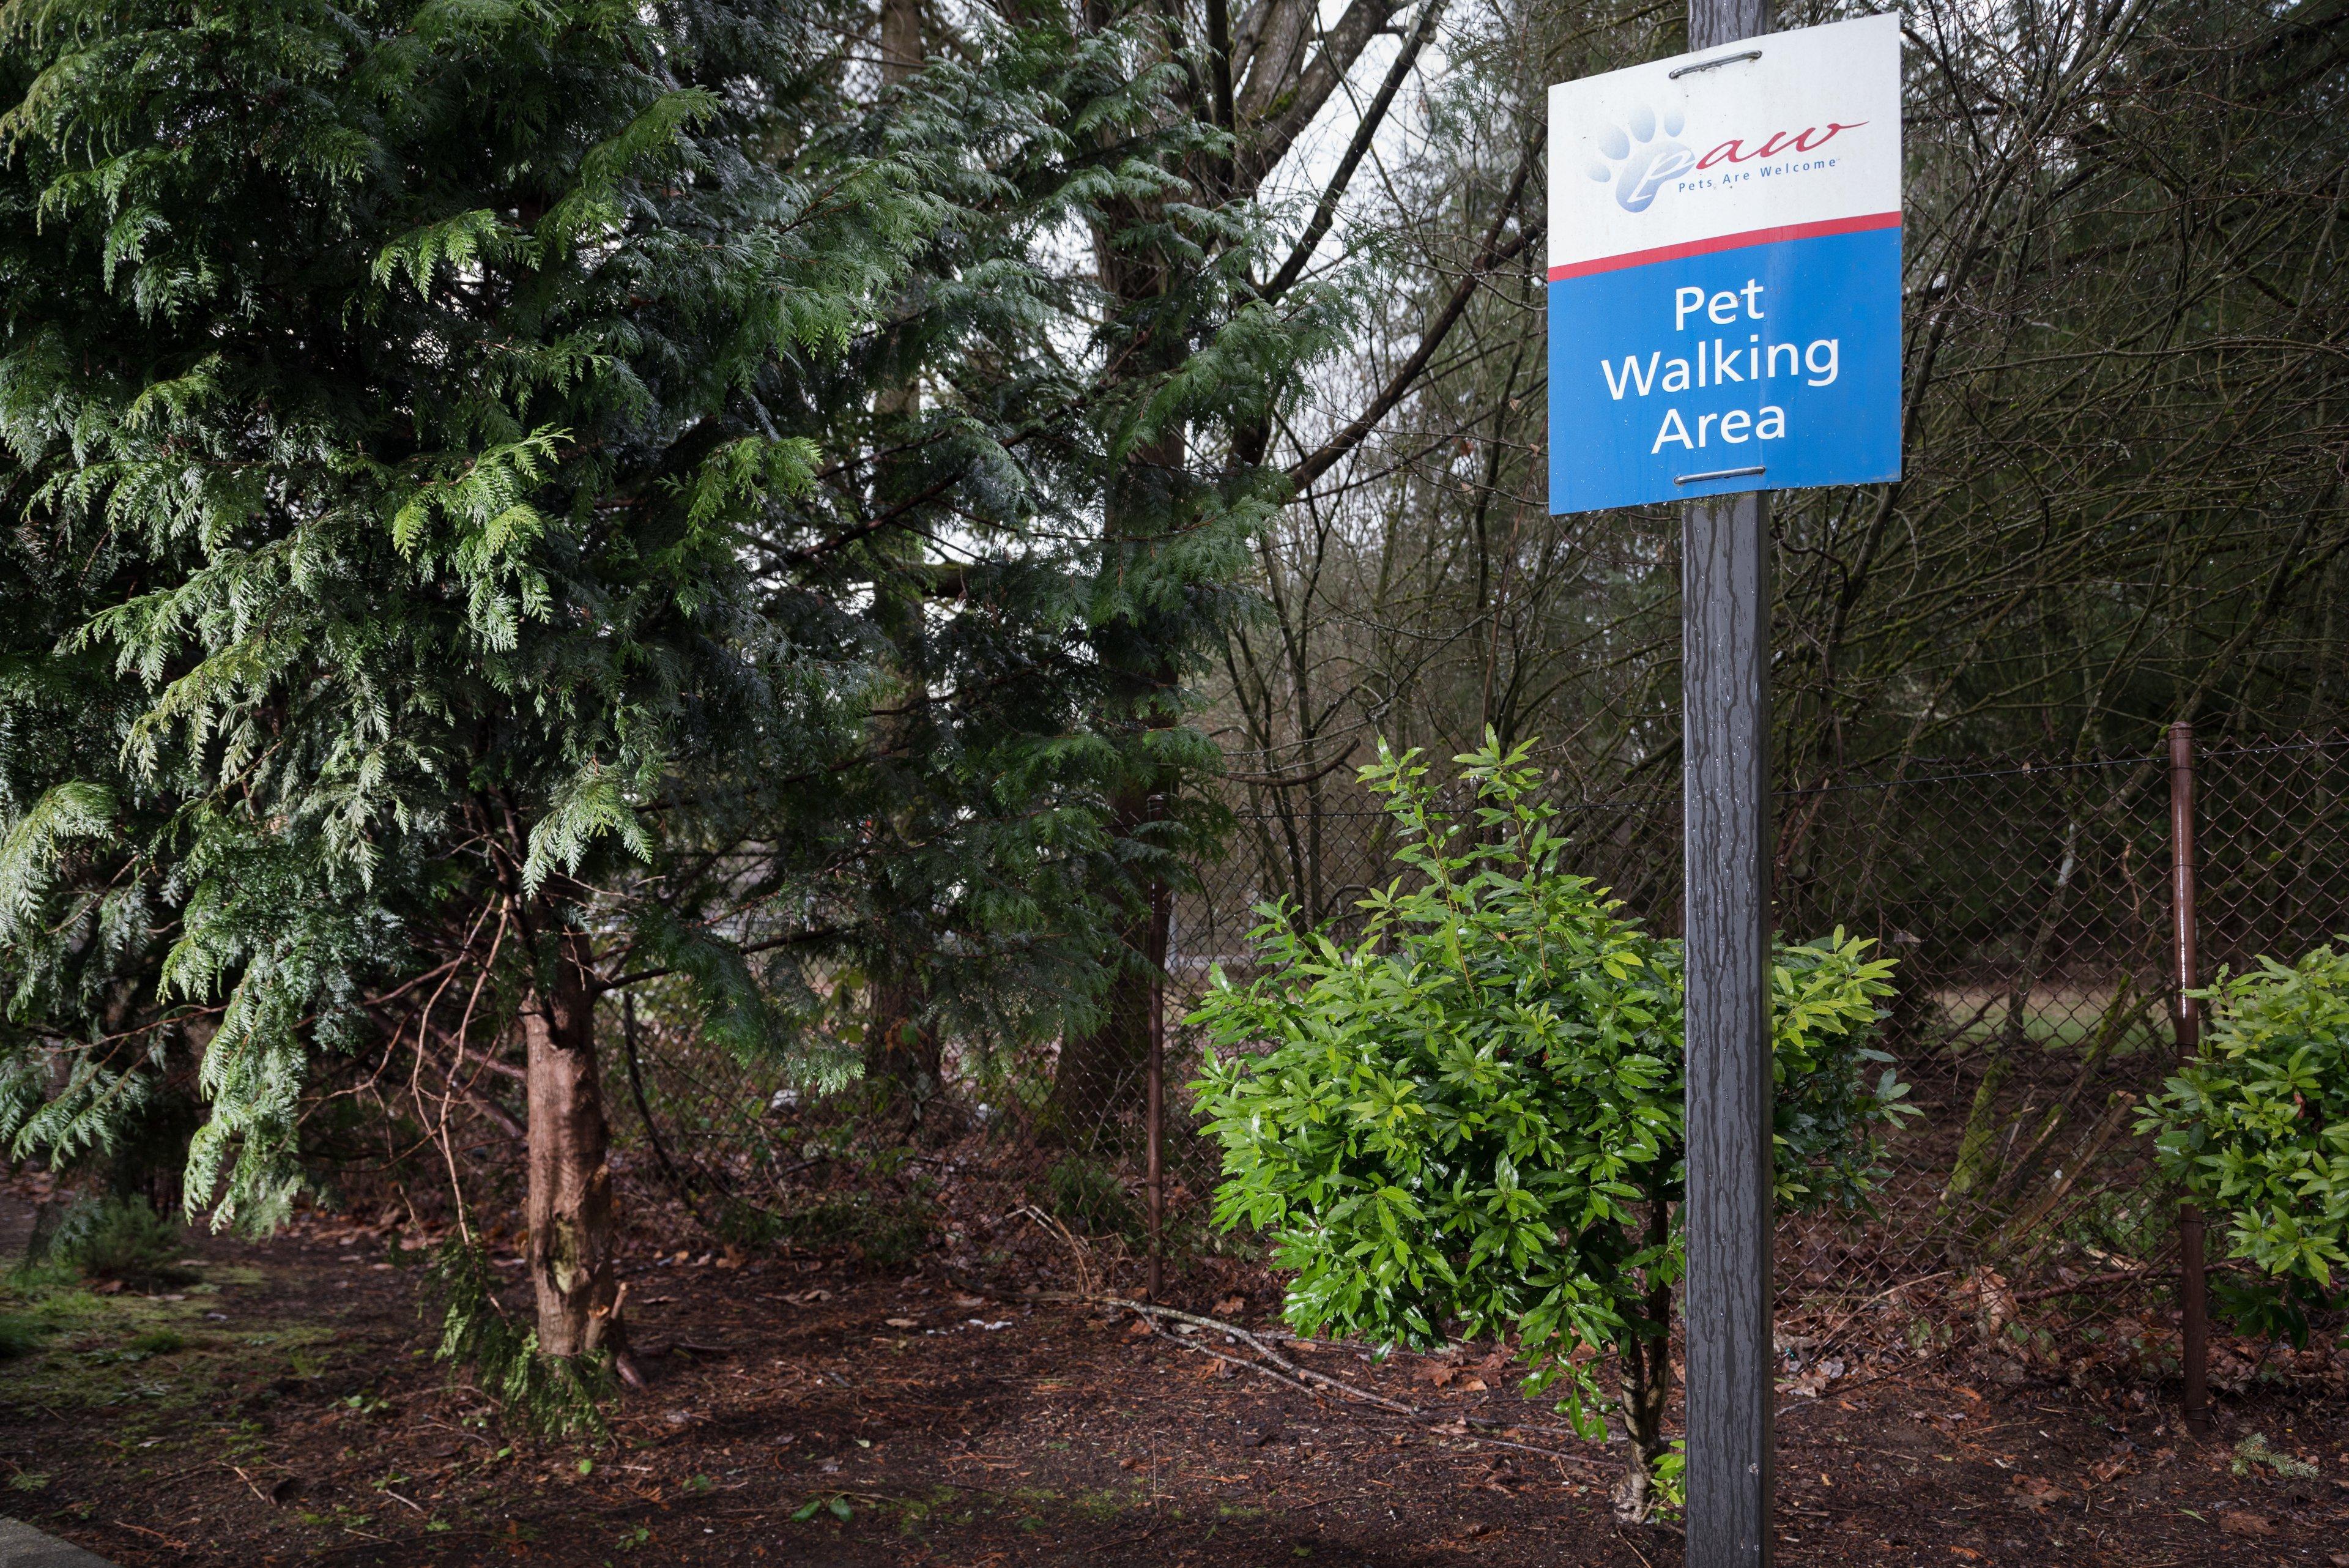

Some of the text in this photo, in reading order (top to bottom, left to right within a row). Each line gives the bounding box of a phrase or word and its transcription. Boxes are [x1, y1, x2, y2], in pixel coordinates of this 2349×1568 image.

[1679, 158, 1836, 193] Pets Are Welcome
[1675, 278, 1764, 331] Pet
[1601, 334, 1839, 400] Walking
[1651, 405, 1786, 454] Area
